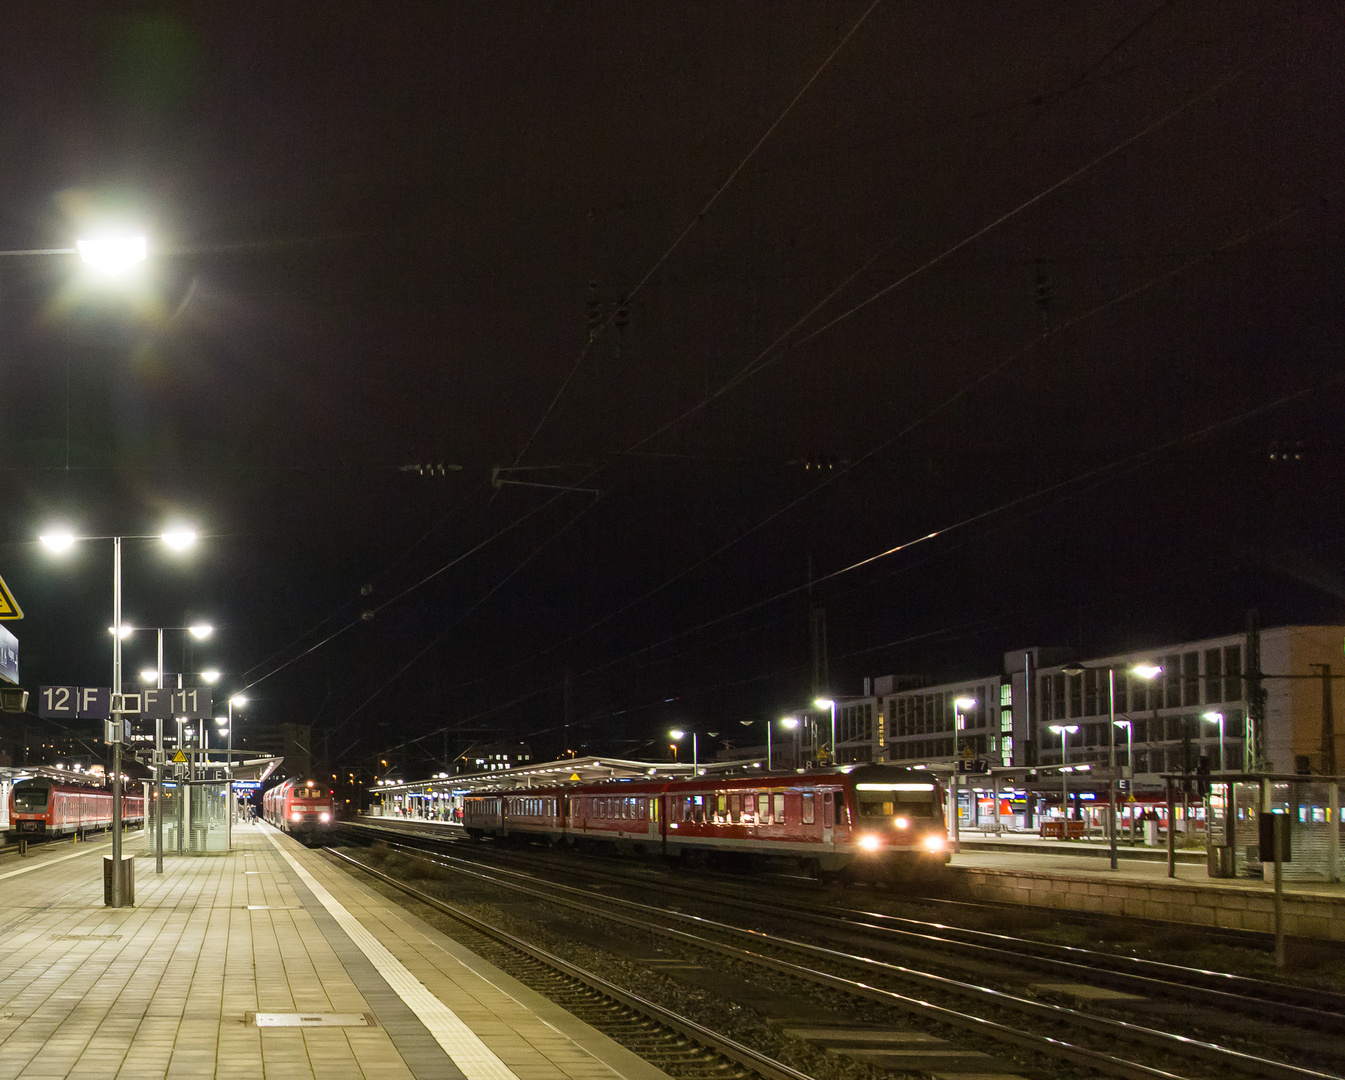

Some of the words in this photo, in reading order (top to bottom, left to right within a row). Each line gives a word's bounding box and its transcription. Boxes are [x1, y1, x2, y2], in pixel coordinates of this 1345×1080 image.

[43, 687, 70, 711] 12
[83, 688, 98, 711] F
[144, 690, 158, 712] F
[177, 690, 197, 712] 11
[964, 760, 972, 771] E
[979, 760, 987, 771] 7
[196, 770, 206, 780] 11
[1118, 779, 1126, 789] E
